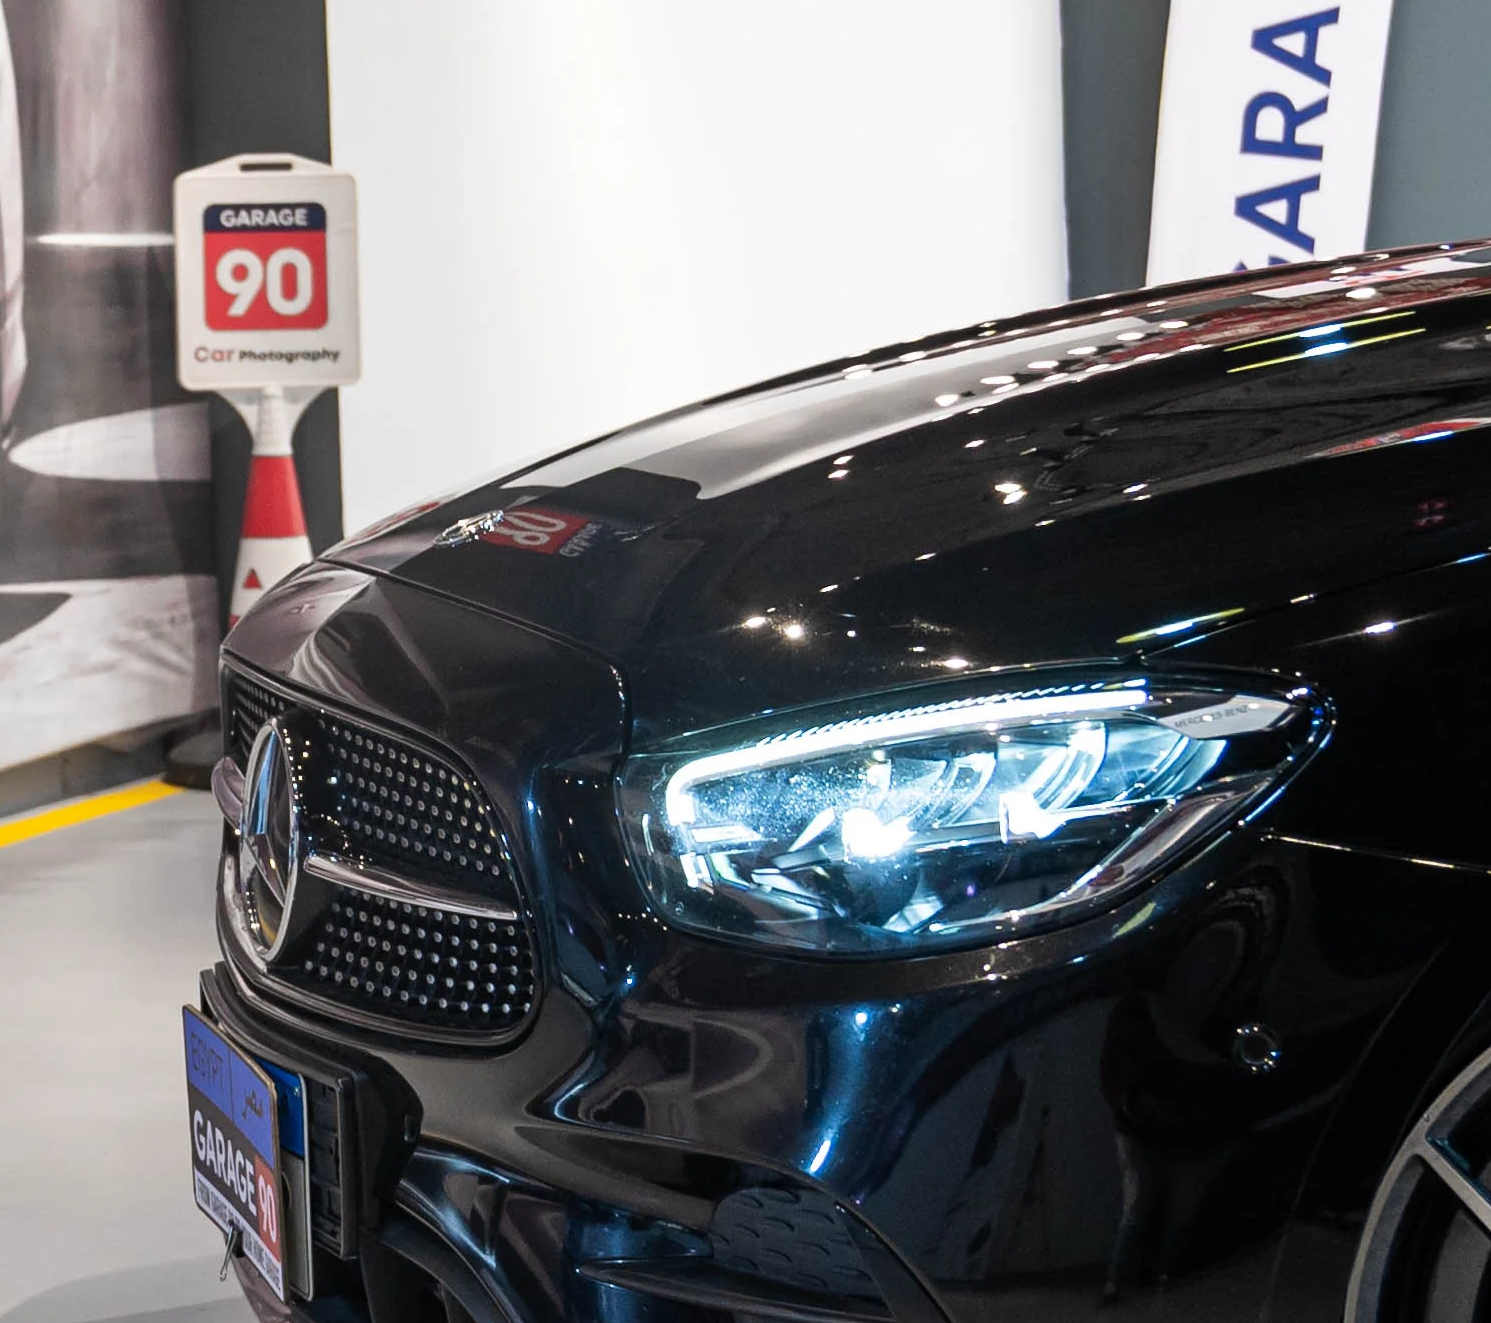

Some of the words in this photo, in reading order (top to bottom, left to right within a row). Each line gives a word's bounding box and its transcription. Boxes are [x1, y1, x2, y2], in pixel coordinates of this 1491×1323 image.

[219, 208, 308, 227] GARAGE
[215, 247, 313, 317] 90
[193, 346, 234, 363] Car
[238, 347, 340, 364] Photography
[1174, 704, 1248, 728] MERCEES-BENZ
[193, 1109, 258, 1217] GARAGE
[258, 1174, 277, 1244] 90
